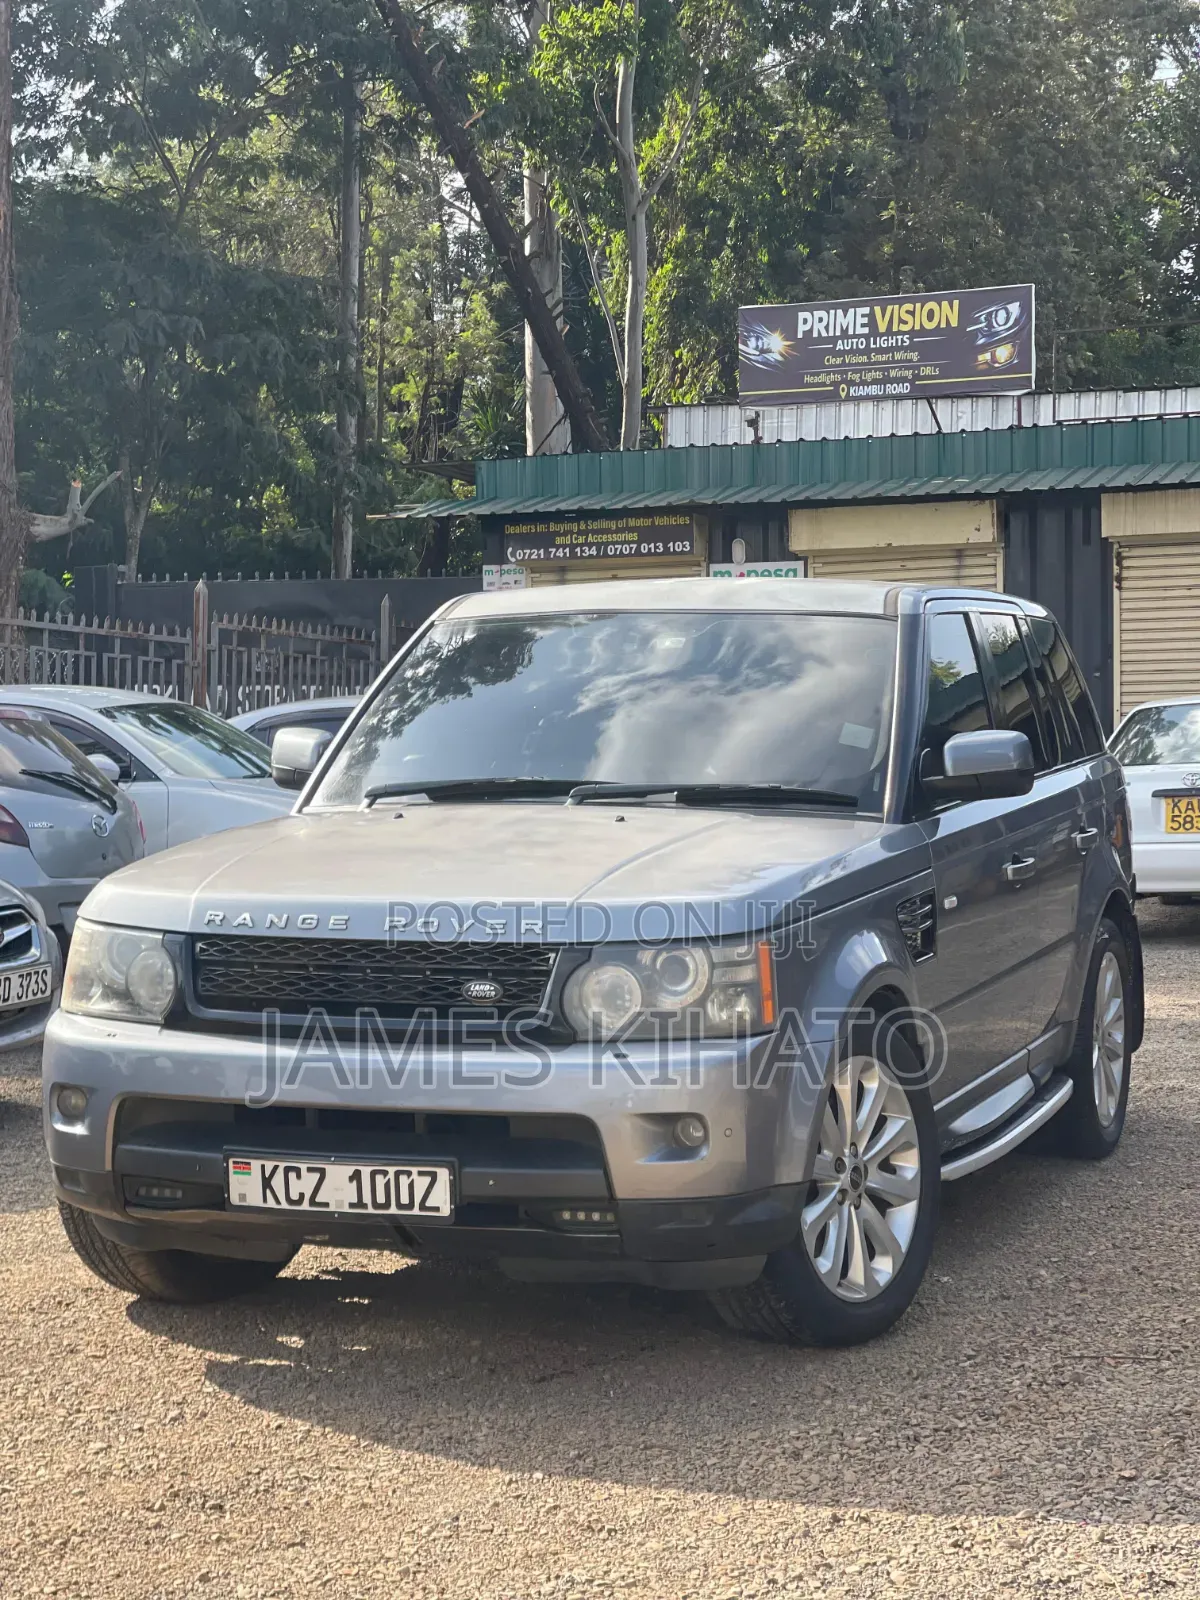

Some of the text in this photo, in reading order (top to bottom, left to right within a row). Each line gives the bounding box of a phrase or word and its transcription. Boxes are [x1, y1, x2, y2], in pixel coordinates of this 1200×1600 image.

[797, 299, 959, 338] PRIME VISION
[836, 335, 910, 350] AUTO LIGHTS
[824, 350, 920, 365] Clear Vision. Smart Wiring.
[804, 367, 939, 384] Headlights Fog Lights Wiring DRLs
[849, 382, 910, 396] KIAMBU ROAD
[504, 515, 690, 534] Dealers in: Buying & Selling of Motor Vehicles
[555, 531, 638, 545] and Car Accessories
[516, 548, 544, 560] 0721
[548, 547, 570, 558] 741
[575, 546, 597, 557] 134
[607, 544, 637, 555] 0707
[641, 542, 664, 553] 013
[668, 541, 690, 552] 103
[1171, 798, 1200, 814] KA
[204, 910, 544, 935] RANGE ROVER
[17, 969, 48, 1001] 373S
[261, 1164, 441, 1213] KCZ 100Z
